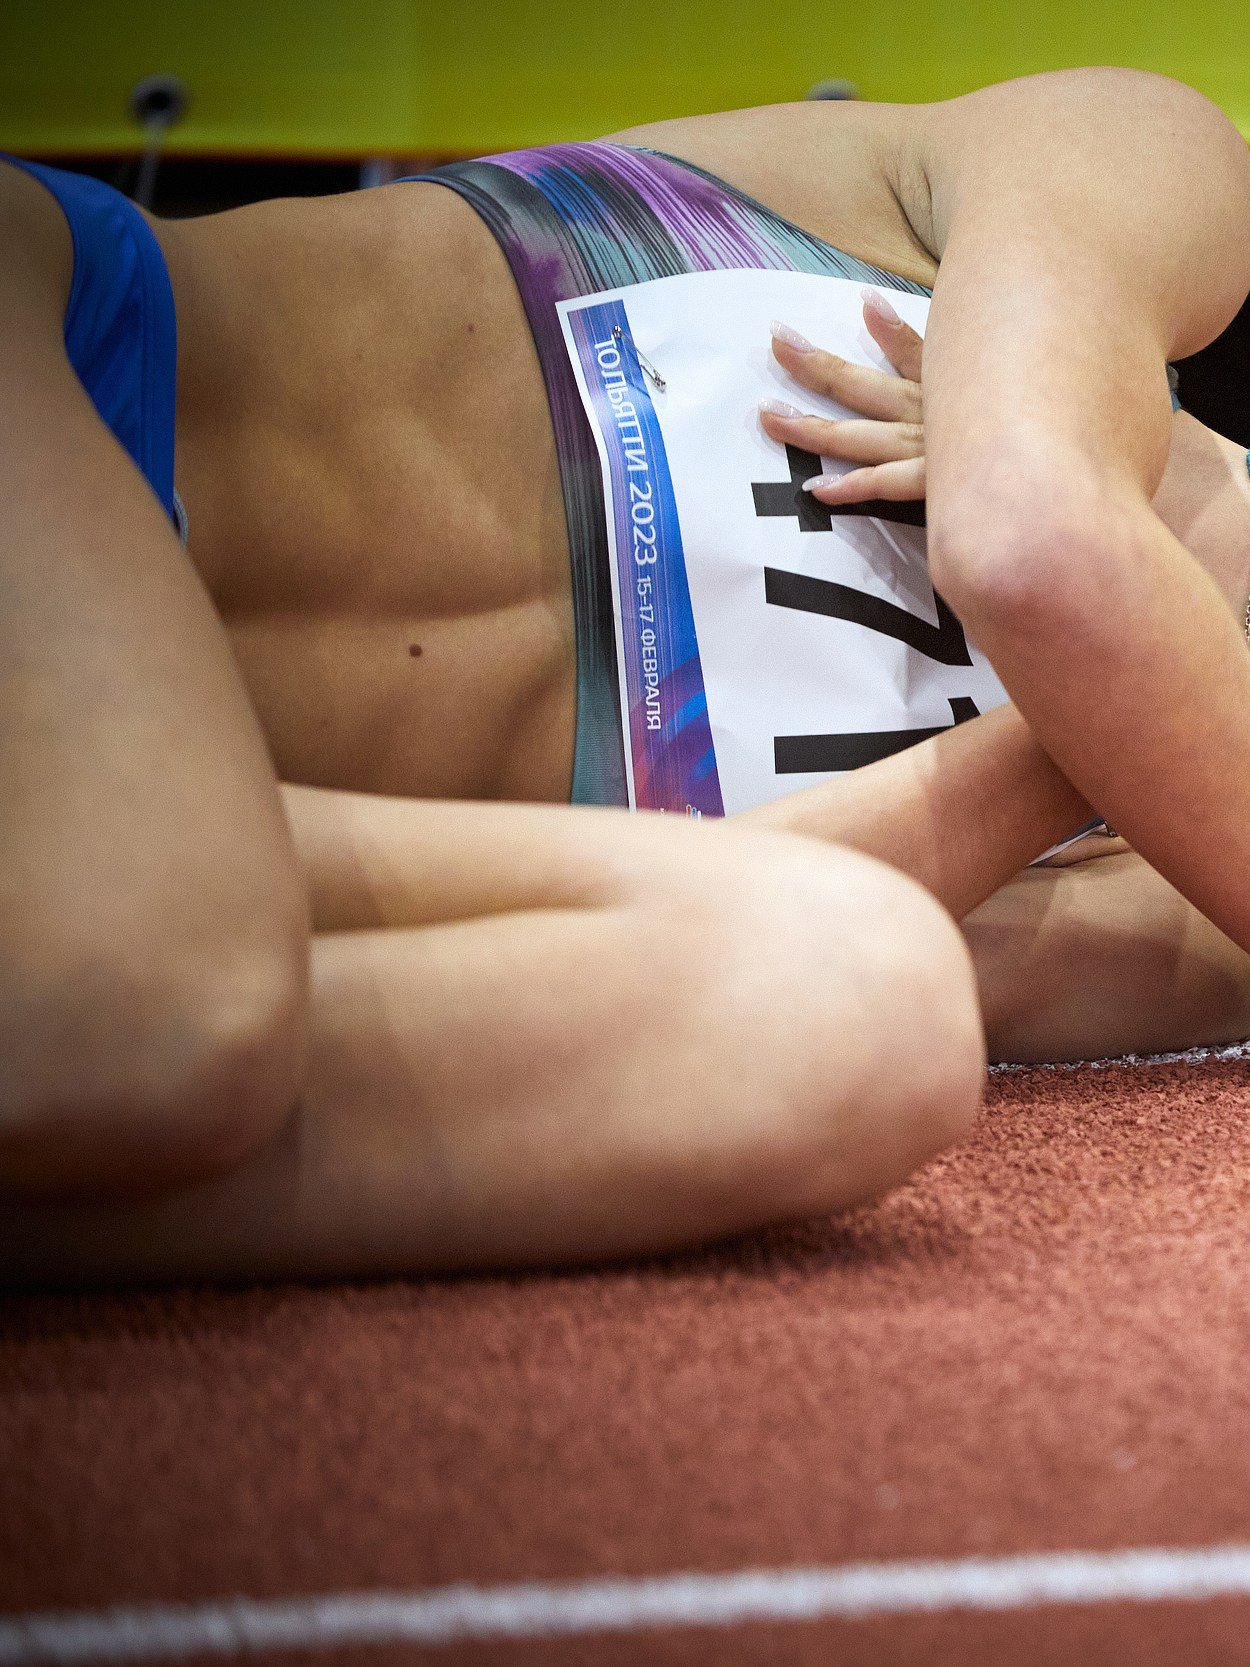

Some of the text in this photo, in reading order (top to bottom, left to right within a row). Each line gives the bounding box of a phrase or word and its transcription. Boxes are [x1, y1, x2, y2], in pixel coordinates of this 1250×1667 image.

[594, 334, 662, 730] ТОЛЬЯТТИ 2023 15-17 ФЕВРАЛЯ
